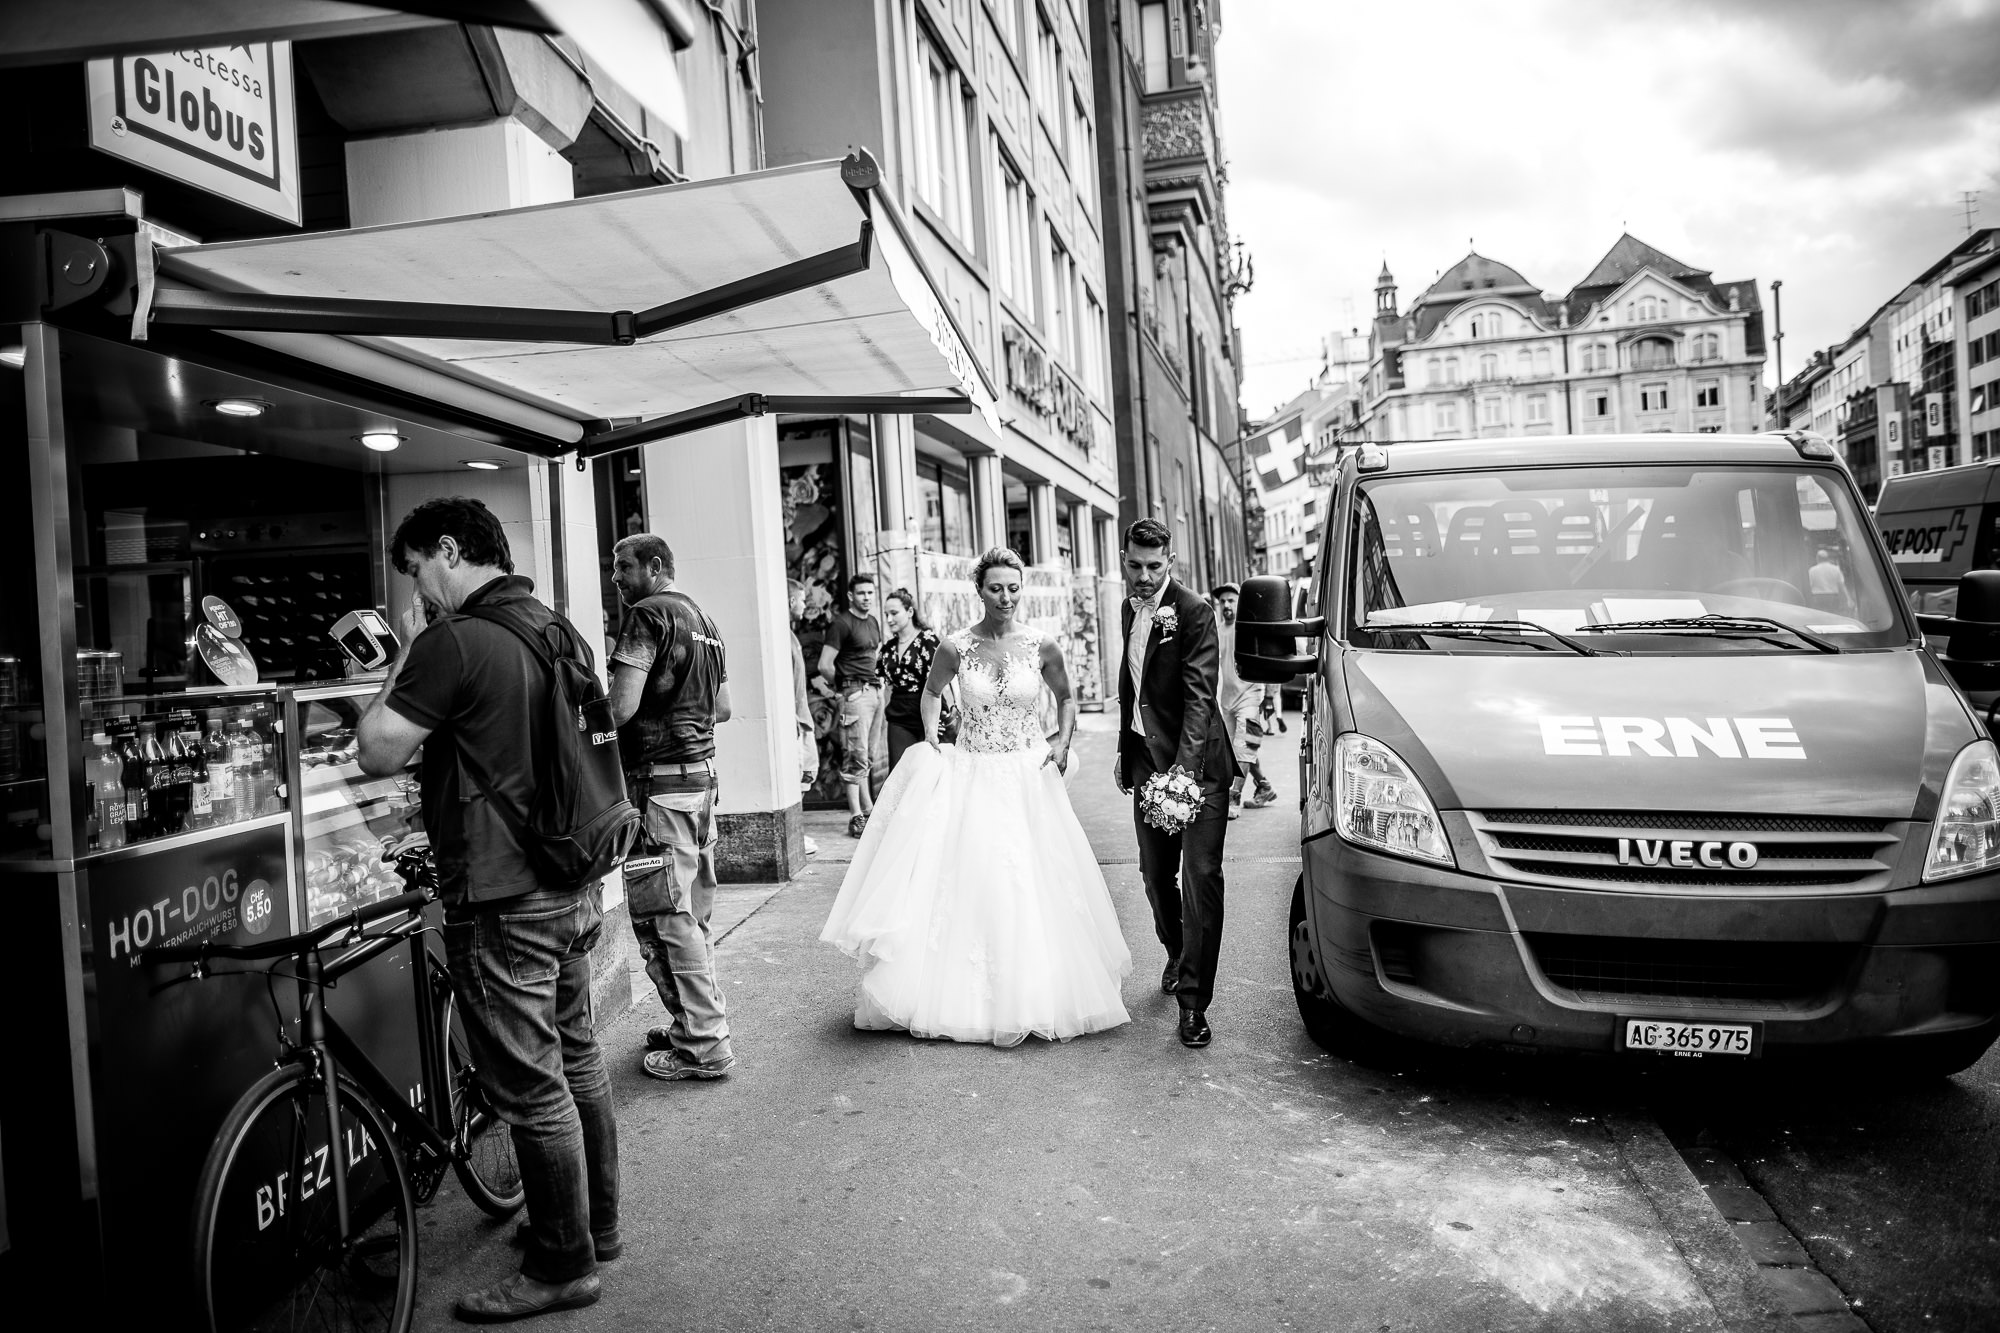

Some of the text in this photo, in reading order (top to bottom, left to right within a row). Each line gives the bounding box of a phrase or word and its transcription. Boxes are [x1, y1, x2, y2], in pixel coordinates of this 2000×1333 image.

[172, 49, 263, 99] catessa
[134, 57, 265, 161] Globus
[1902, 525, 1948, 555] POST
[1538, 716, 1807, 760] ERNE
[1618, 838, 1758, 869] IVECO
[246, 897, 272, 924] 5.50
[250, 889, 265, 905] CHF
[109, 868, 239, 960] HOT-DOG
[1674, 1050, 1692, 1058] ERNE
